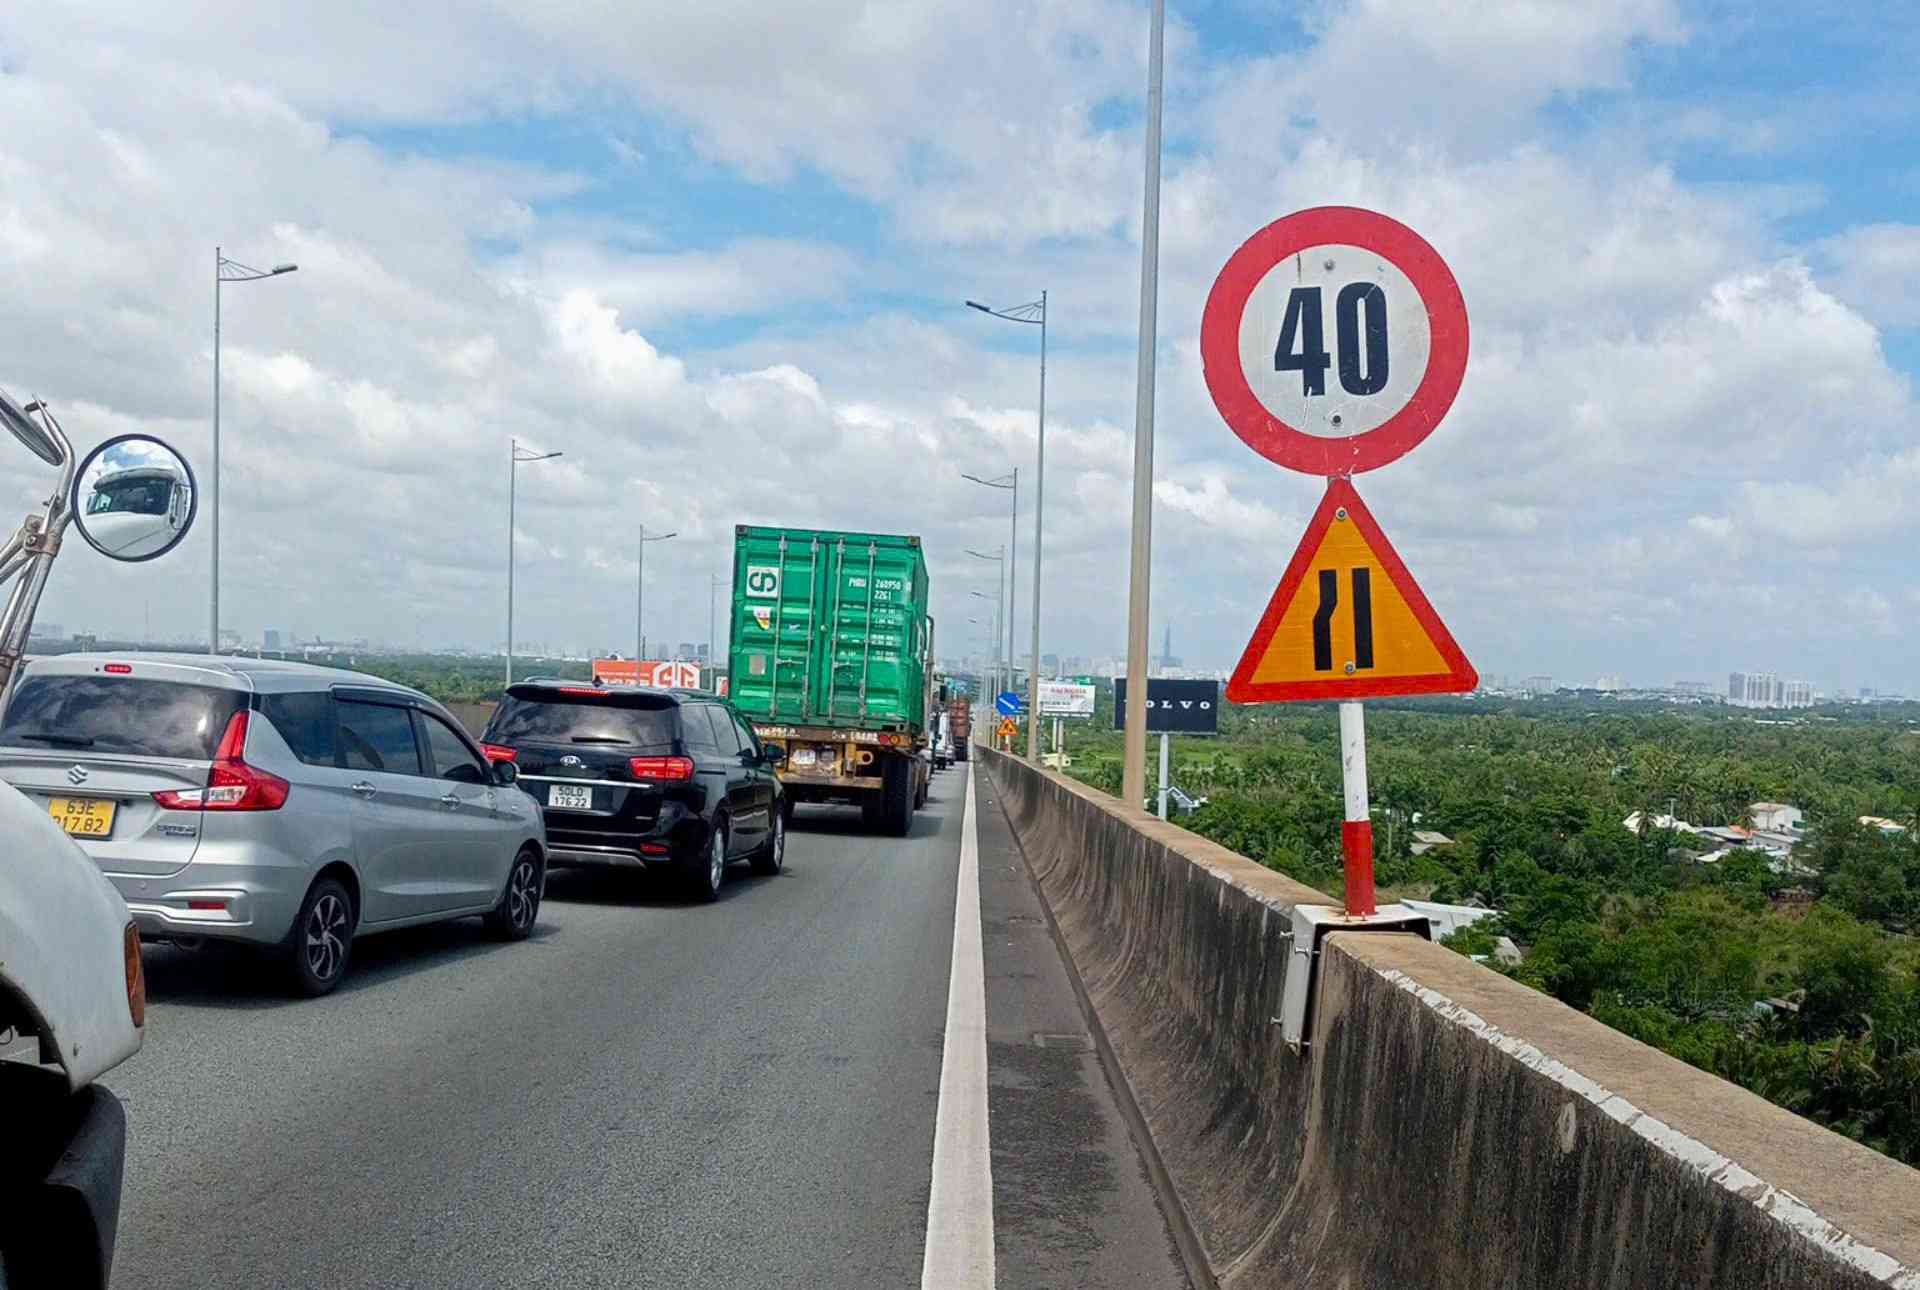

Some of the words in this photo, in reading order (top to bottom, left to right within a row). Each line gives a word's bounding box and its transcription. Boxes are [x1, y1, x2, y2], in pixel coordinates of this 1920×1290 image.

[1275, 282, 1389, 396] 40
[1124, 699, 1210, 710] OLVO
[66, 800, 96, 815] 63E
